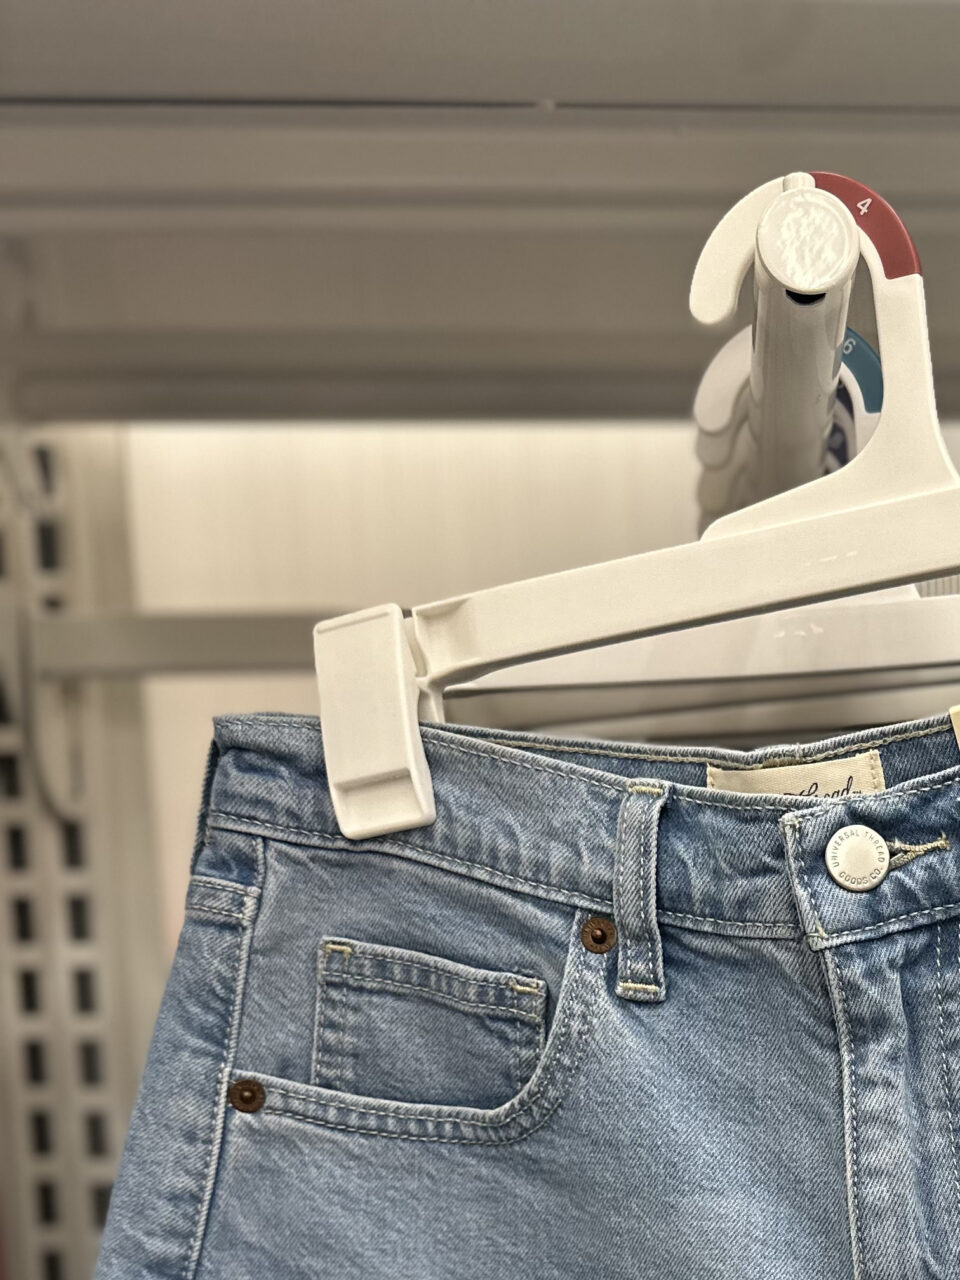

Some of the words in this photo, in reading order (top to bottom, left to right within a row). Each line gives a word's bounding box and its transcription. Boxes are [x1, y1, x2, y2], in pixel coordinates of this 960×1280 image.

[857, 198, 872, 215] 4
[842, 338, 856, 355] 6
[831, 830, 859, 868] UNIVERSAL
[864, 831, 885, 863] THREAD
[839, 871, 869, 885] GOODS
